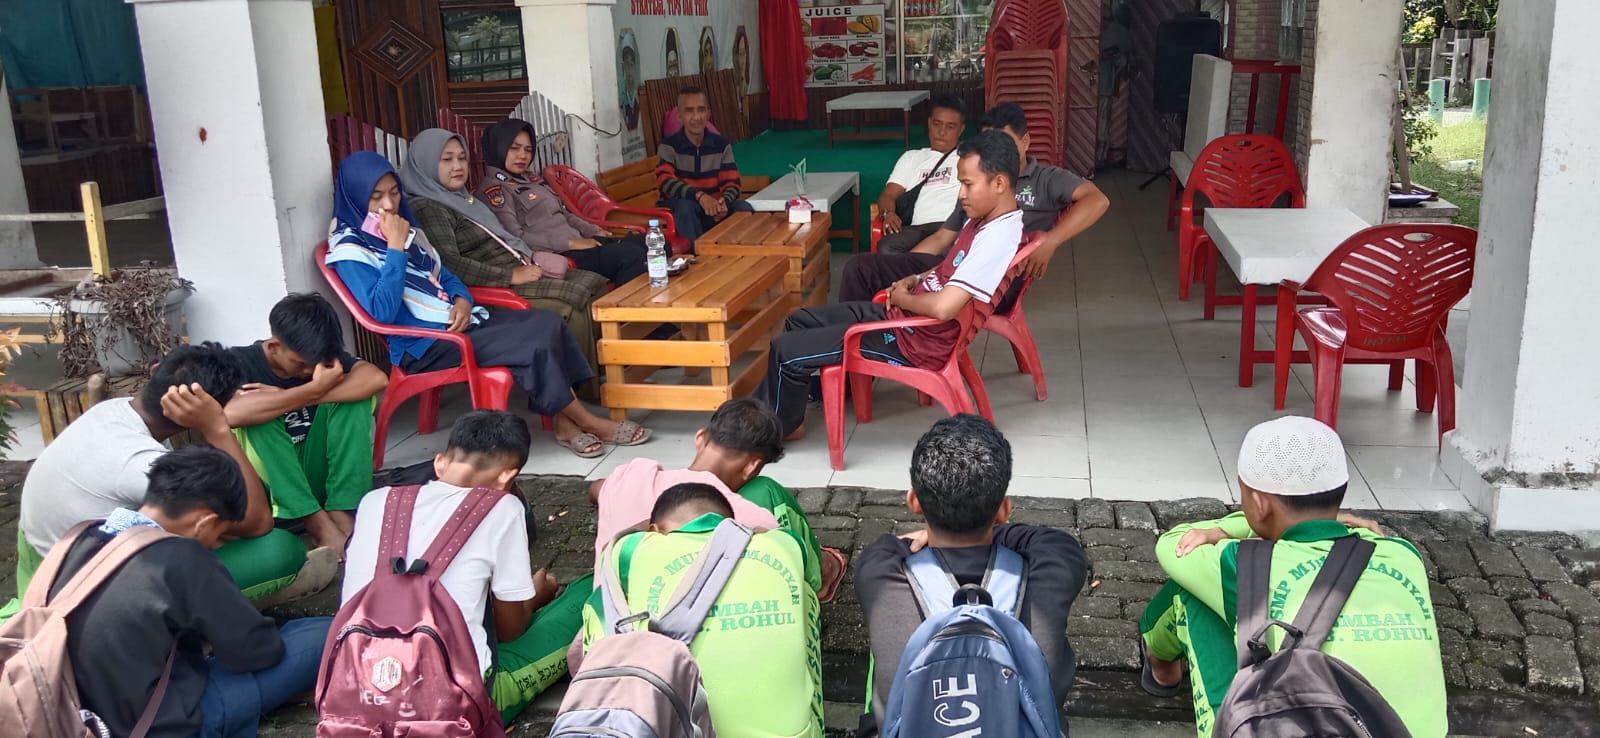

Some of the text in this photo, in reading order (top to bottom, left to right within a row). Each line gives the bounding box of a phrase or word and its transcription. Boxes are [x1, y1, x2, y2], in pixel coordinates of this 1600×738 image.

[805, 7, 852, 17] JUICE
[664, 550, 800, 605] MUMADIYAH
[706, 600, 780, 617] MBAH
[1269, 580, 1291, 621] SMP
[720, 612, 796, 631] ROHUL
[1333, 613, 1415, 627] MBAH
[1352, 627, 1432, 641] ROHUL
